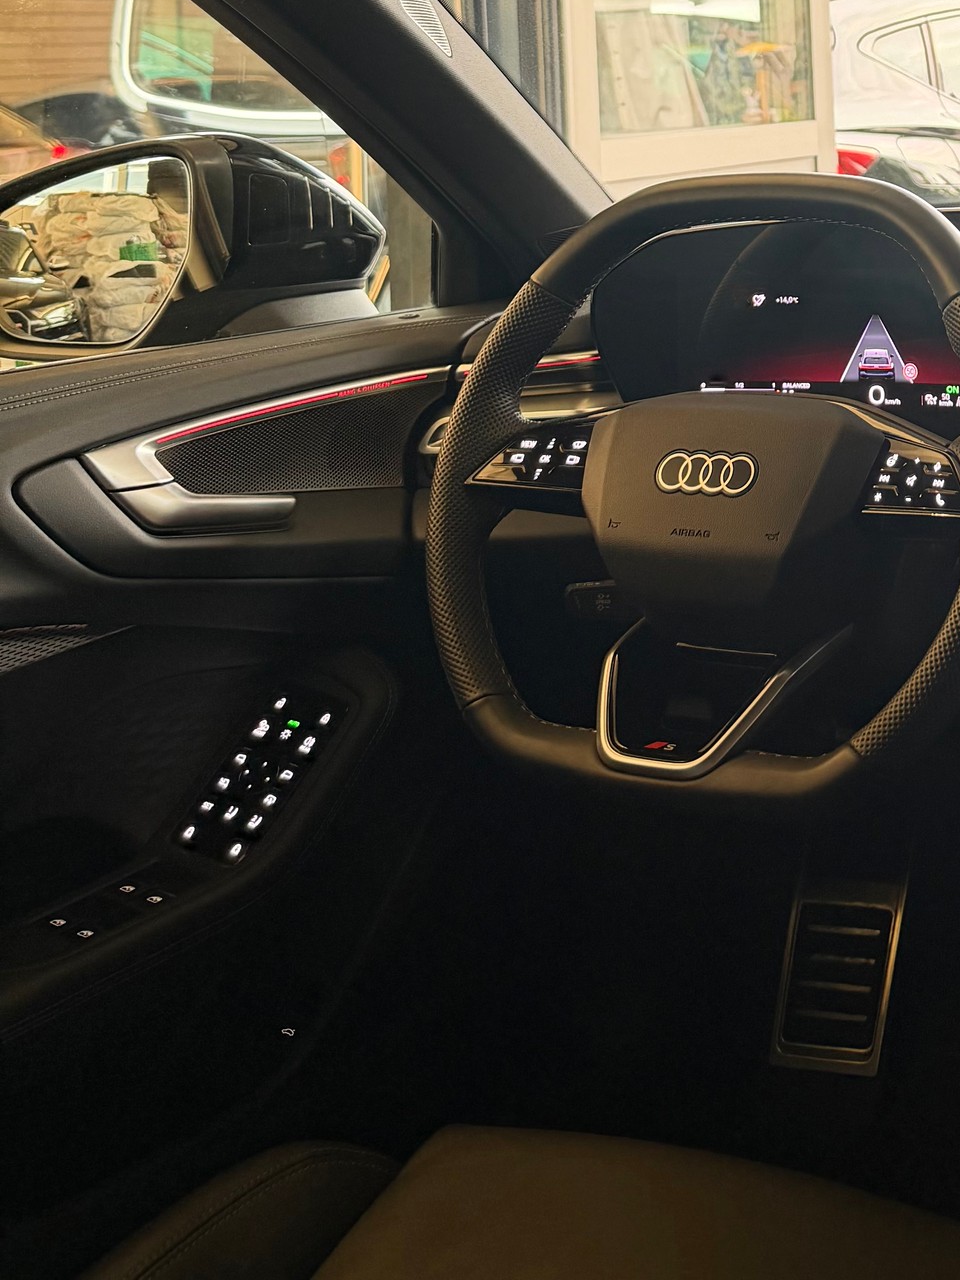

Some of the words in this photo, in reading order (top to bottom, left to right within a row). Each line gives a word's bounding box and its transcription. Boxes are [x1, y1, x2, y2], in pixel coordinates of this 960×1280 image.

[946, 385, 960, 395] ON
[868, 384, 886, 406] 0
[885, 397, 901, 405] km/h
[941, 393, 951, 401] 50
[520, 440, 537, 448] VIEW
[538, 454, 552, 463] OK
[670, 528, 711, 538] AIRBAG
